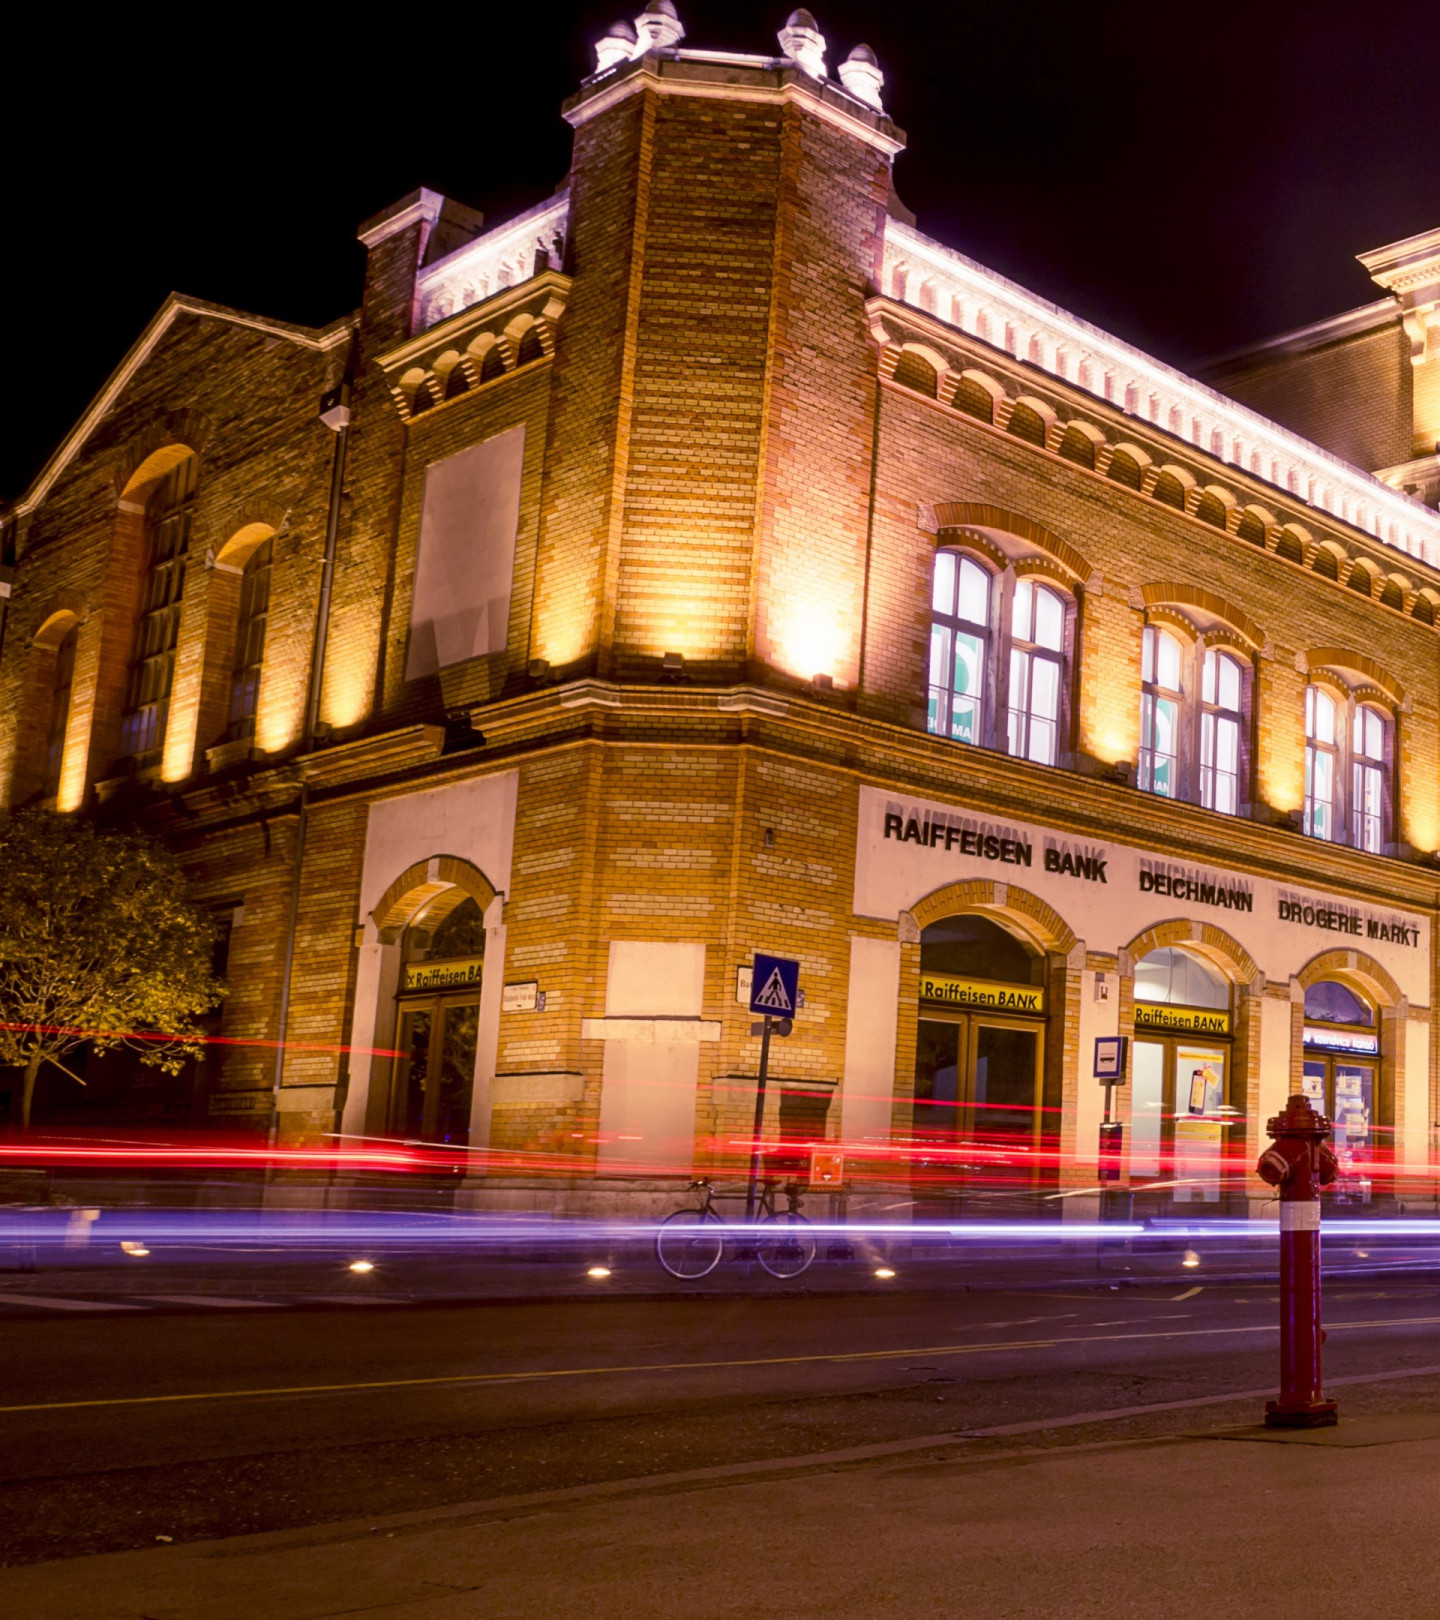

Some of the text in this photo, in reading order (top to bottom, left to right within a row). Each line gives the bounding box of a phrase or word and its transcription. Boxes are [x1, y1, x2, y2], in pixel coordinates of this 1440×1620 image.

[883, 812, 1108, 884] RAIFFEISEN BANK
[1138, 870, 1253, 912] DEICHMANN
[1278, 900, 1421, 948] DROGERIE MARKT
[416, 968, 467, 987] Raiffeisen
[924, 981, 1038, 1009] Raiffeisen BANK
[1135, 1008, 1225, 1032] Raiffeisen BANK
